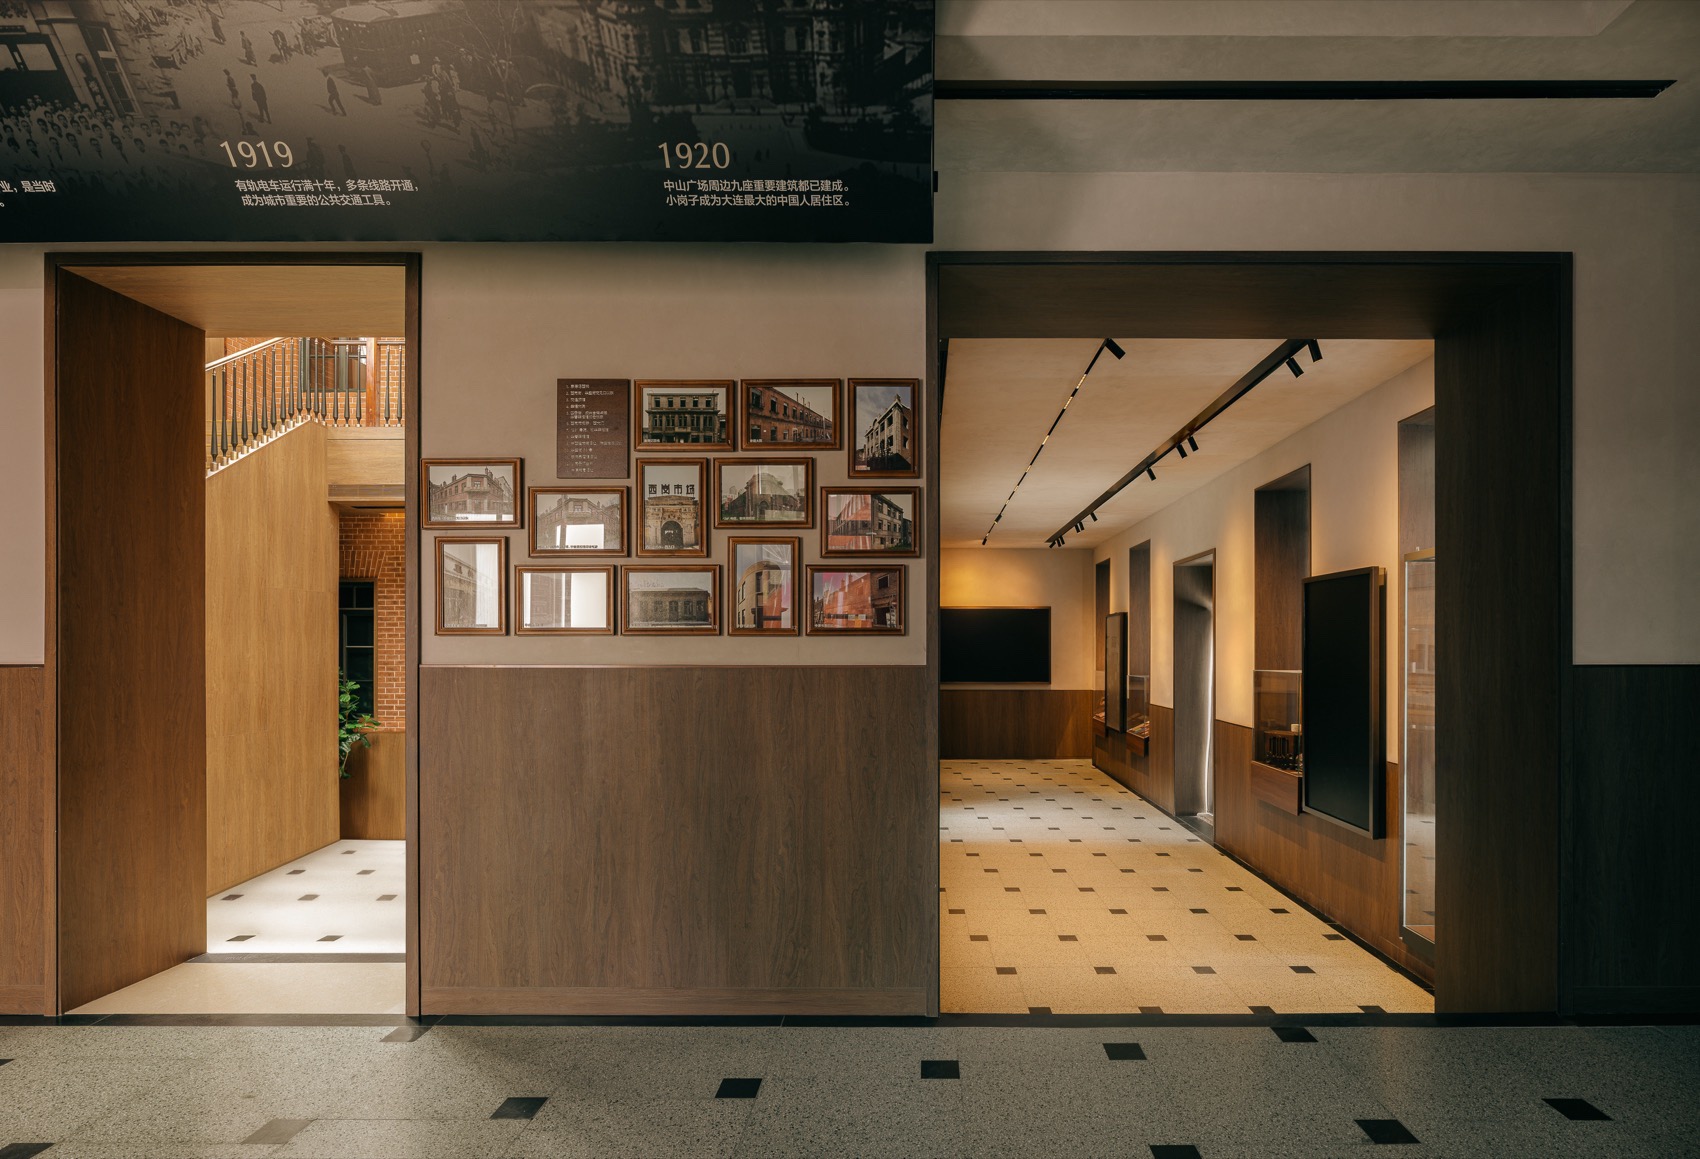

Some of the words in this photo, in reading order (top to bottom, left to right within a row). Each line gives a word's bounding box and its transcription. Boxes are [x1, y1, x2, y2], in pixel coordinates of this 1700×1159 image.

[219, 140, 294, 168] 1919
[657, 142, 731, 169] 1920
[234, 179, 419, 193] 有轨电车运行满十年，多条线路开通，
[663, 179, 849, 192] 中山广场周边九座重要建筑都已建成。
[241, 194, 392, 207] 成为城市重要的公共交通工具。
[666, 194, 850, 207] 小岗子成为大连最大的中国人居住区。
